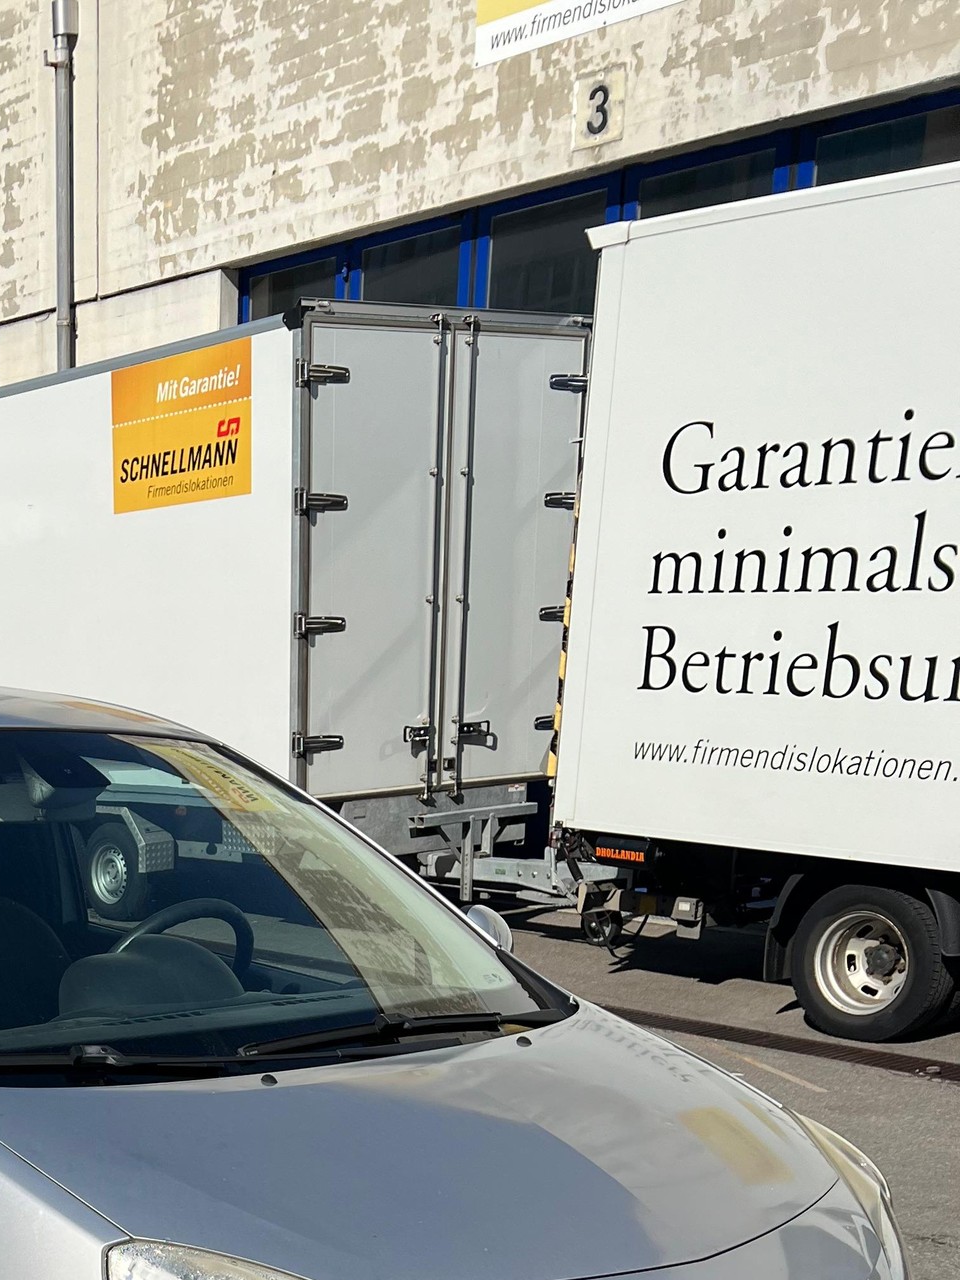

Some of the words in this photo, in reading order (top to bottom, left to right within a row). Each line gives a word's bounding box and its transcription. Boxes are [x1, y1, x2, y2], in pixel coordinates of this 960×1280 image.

[587, 85, 609, 134] 3
[156, 380, 179, 403] Mit
[179, 364, 241, 398] Garantie!
[120, 439, 239, 483] SCHNELLMANN
[662, 408, 960, 494] Garantie
[147, 475, 234, 499] Firmendislokationen
[647, 510, 959, 595] minimals
[634, 738, 959, 782] www.firmendislokationen.
[595, 846, 645, 862] DHOLLANDIA
